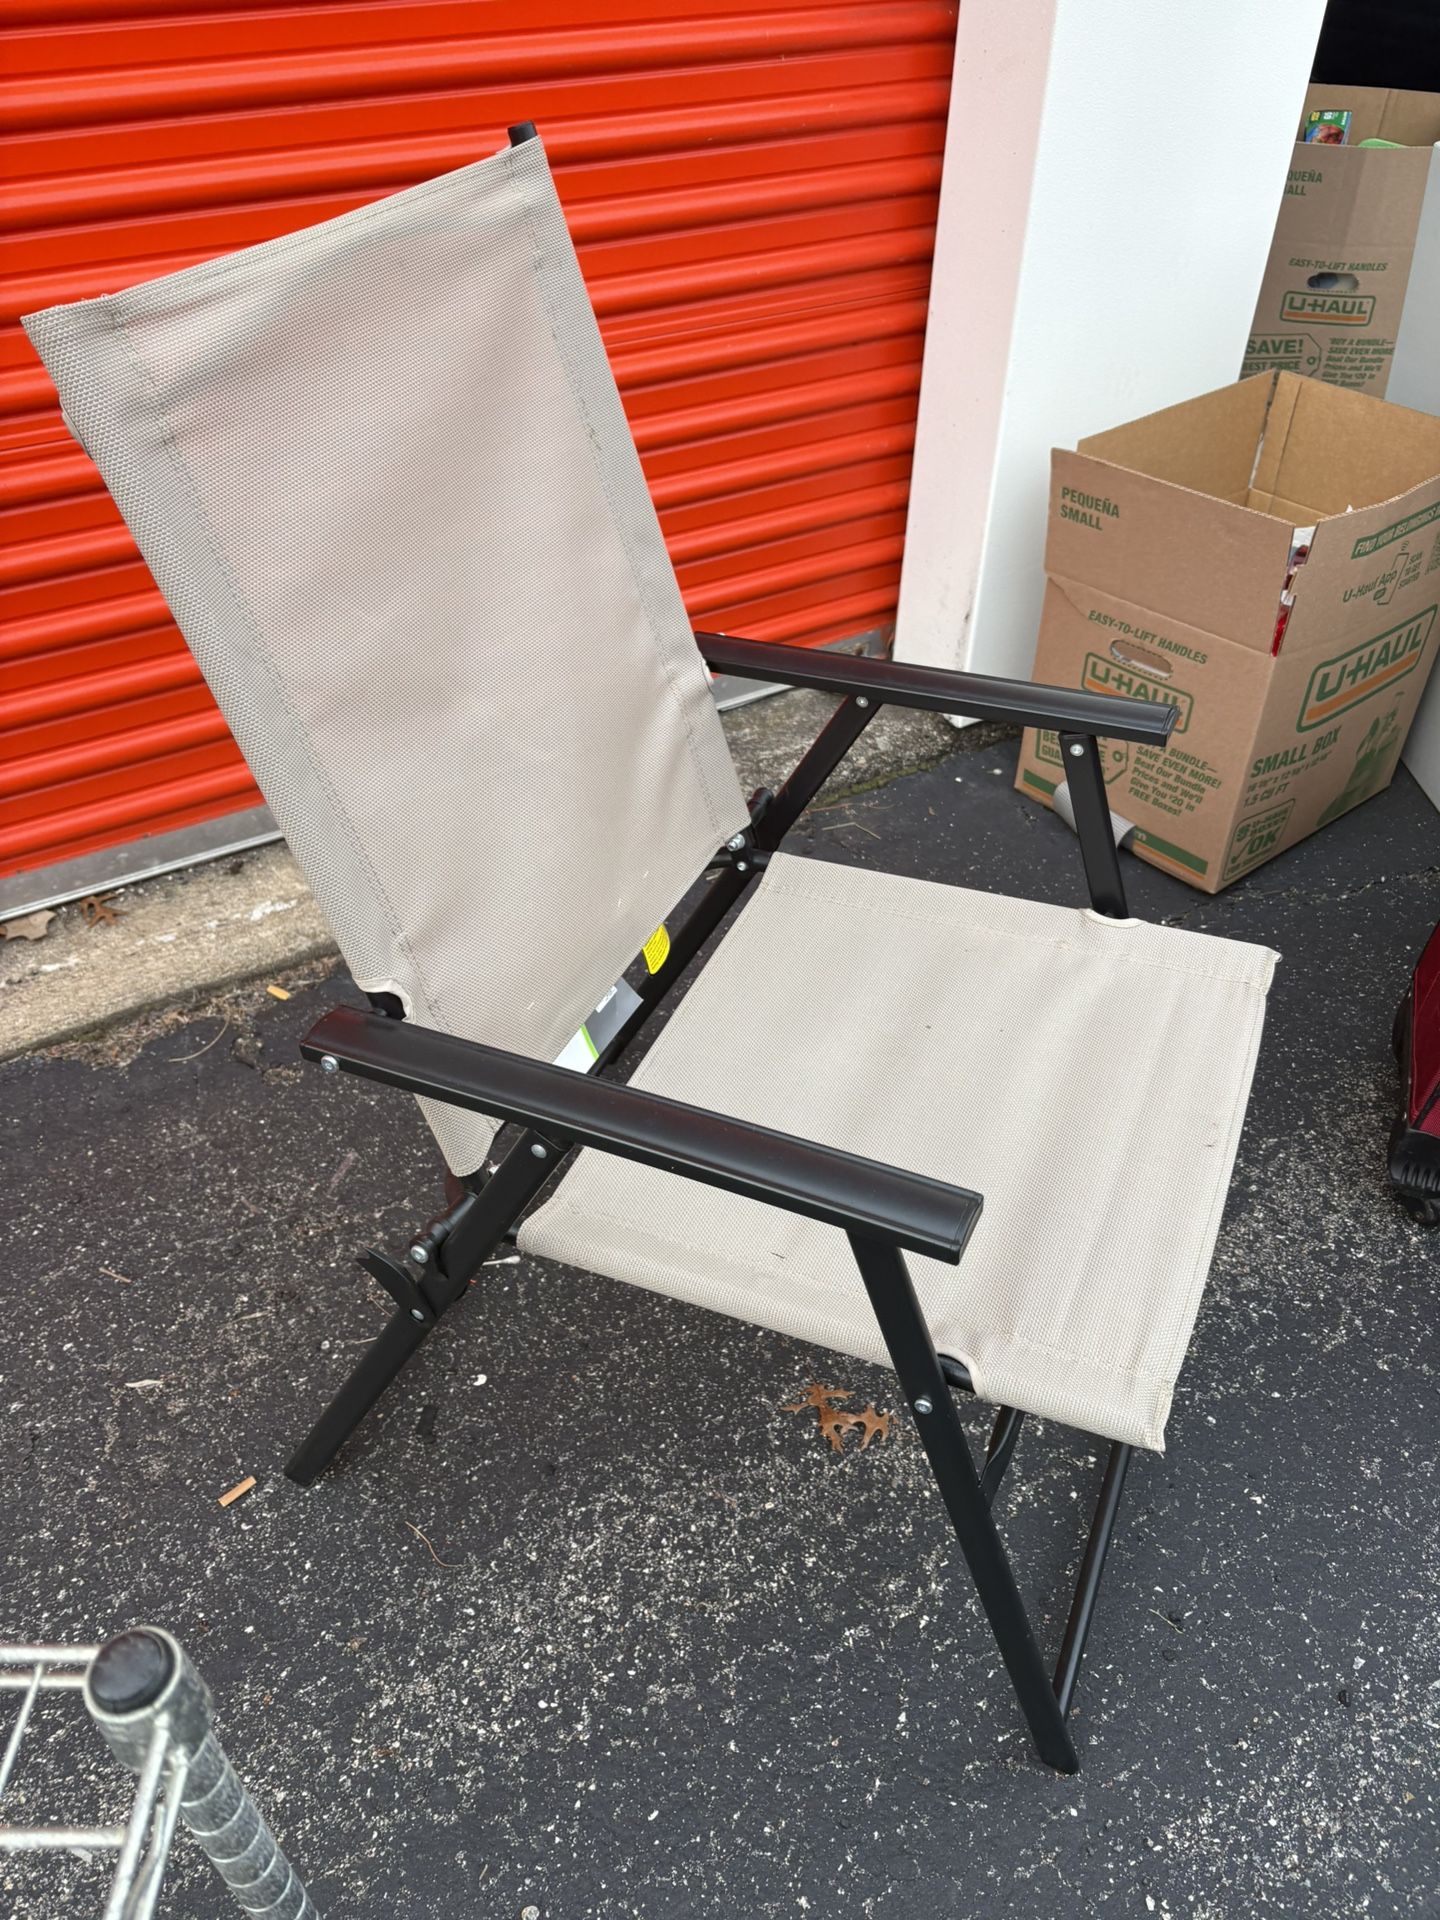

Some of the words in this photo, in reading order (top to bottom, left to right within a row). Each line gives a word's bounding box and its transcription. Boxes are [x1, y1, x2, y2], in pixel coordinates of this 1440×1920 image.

[1288, 258, 1346, 271] EASY-TO-LIFT
[1347, 262, 1388, 271] HANDLES
[1288, 296, 1368, 315] U-HAUL
[1246, 339, 1303, 354] SAVE!
[1061, 486, 1120, 518] PEQUEÑA
[1060, 504, 1103, 531] SMALL
[1342, 576, 1380, 602] U-Haul
[1378, 570, 1397, 587] App
[1088, 610, 1156, 644] EASY-TO-LIFT
[1157, 637, 1208, 665] HANDLES
[1316, 623, 1422, 702] U-HAUL
[1250, 744, 1306, 778] SMALL
[1312, 726, 1341, 755] BOX
[1131, 767, 1159, 785] Prices
[1161, 781, 1179, 793] and
[1134, 756, 1155, 771] Beat
[1156, 766, 1173, 779] Our
[1174, 774, 1206, 795] Bundle
[1136, 745, 1162, 763] SAVE
[1162, 757, 1188, 775] EVEN
[1188, 769, 1222, 790] MORE!
[1128, 787, 1152, 802] FREE
[1152, 798, 1182, 816] Boxes!
[1151, 786, 1168, 799] You
[1248, 826, 1282, 855] OK
